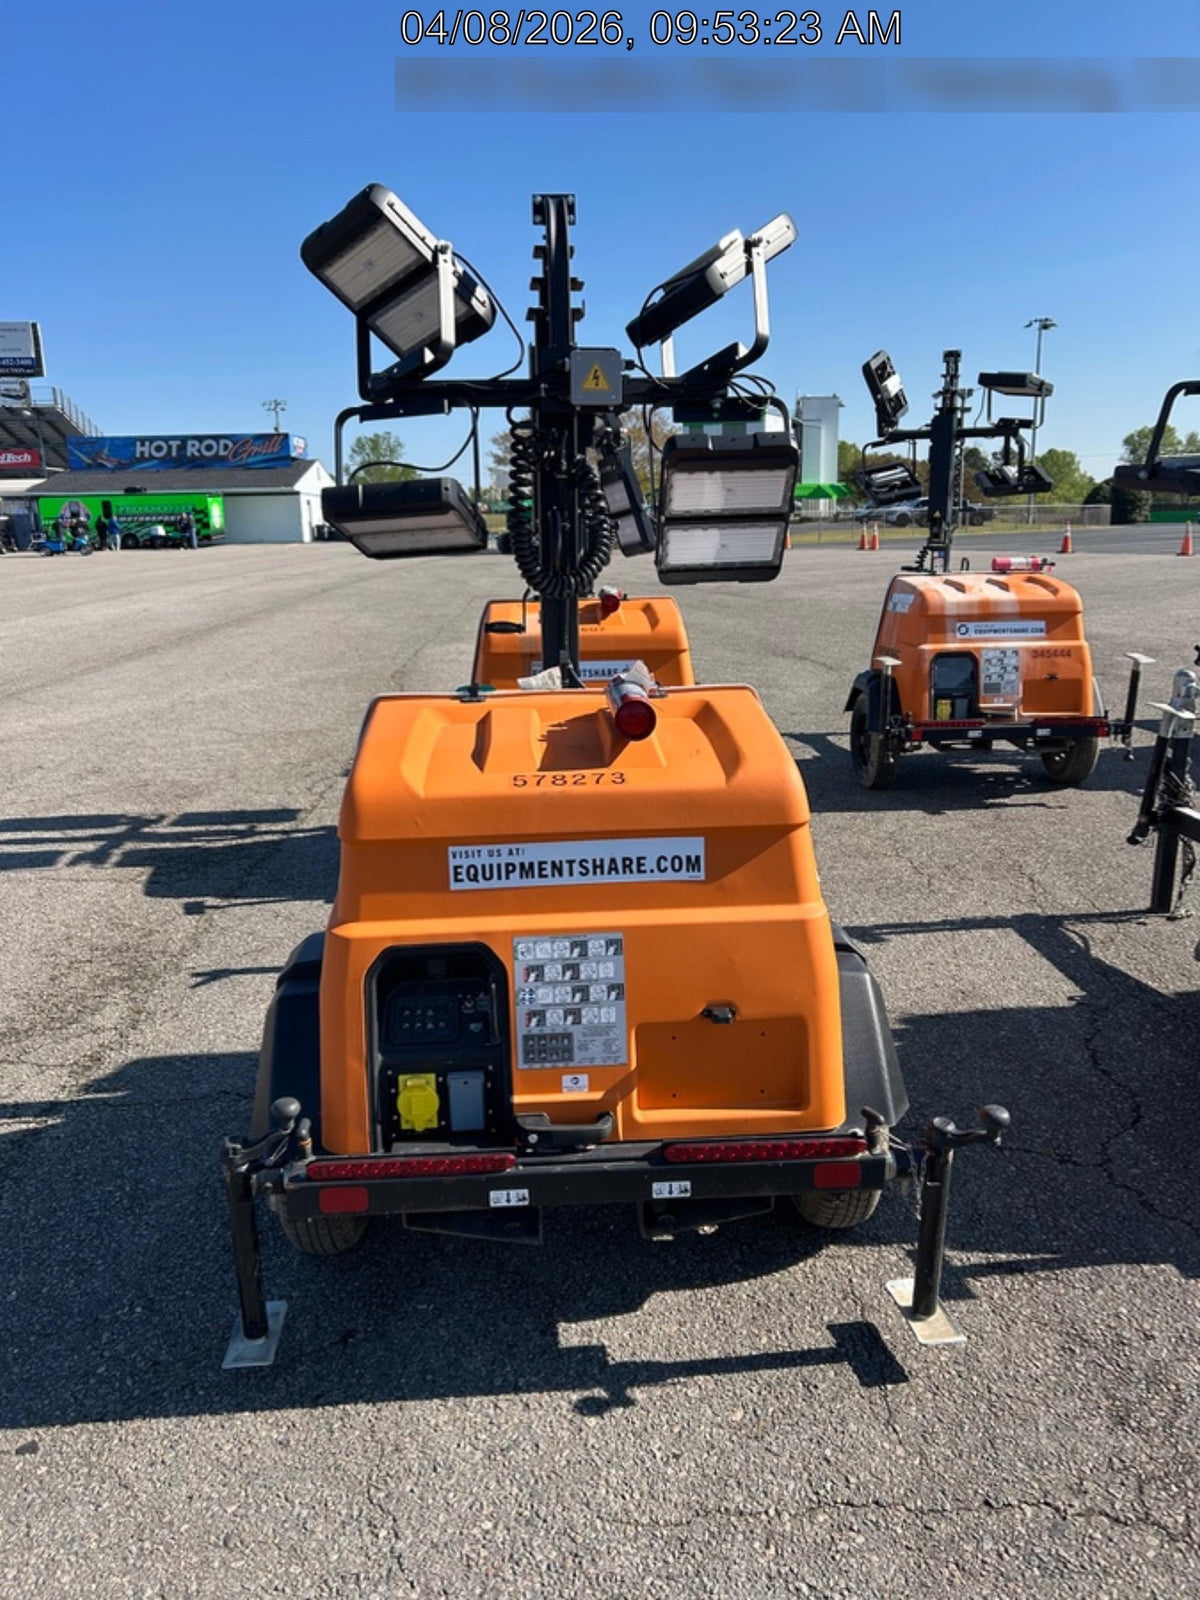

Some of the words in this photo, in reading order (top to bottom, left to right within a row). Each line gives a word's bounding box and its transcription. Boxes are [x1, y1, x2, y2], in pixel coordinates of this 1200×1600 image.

[135, 440, 181, 459] HOT
[186, 438, 233, 457] ROD
[229, 435, 283, 462] Grill
[512, 771, 627, 788] 578273
[451, 848, 482, 860] VISIT
[487, 848, 502, 858] US
[507, 847, 525, 858] AT:
[452, 854, 702, 883] EQUIPMENTSHARE.COM
